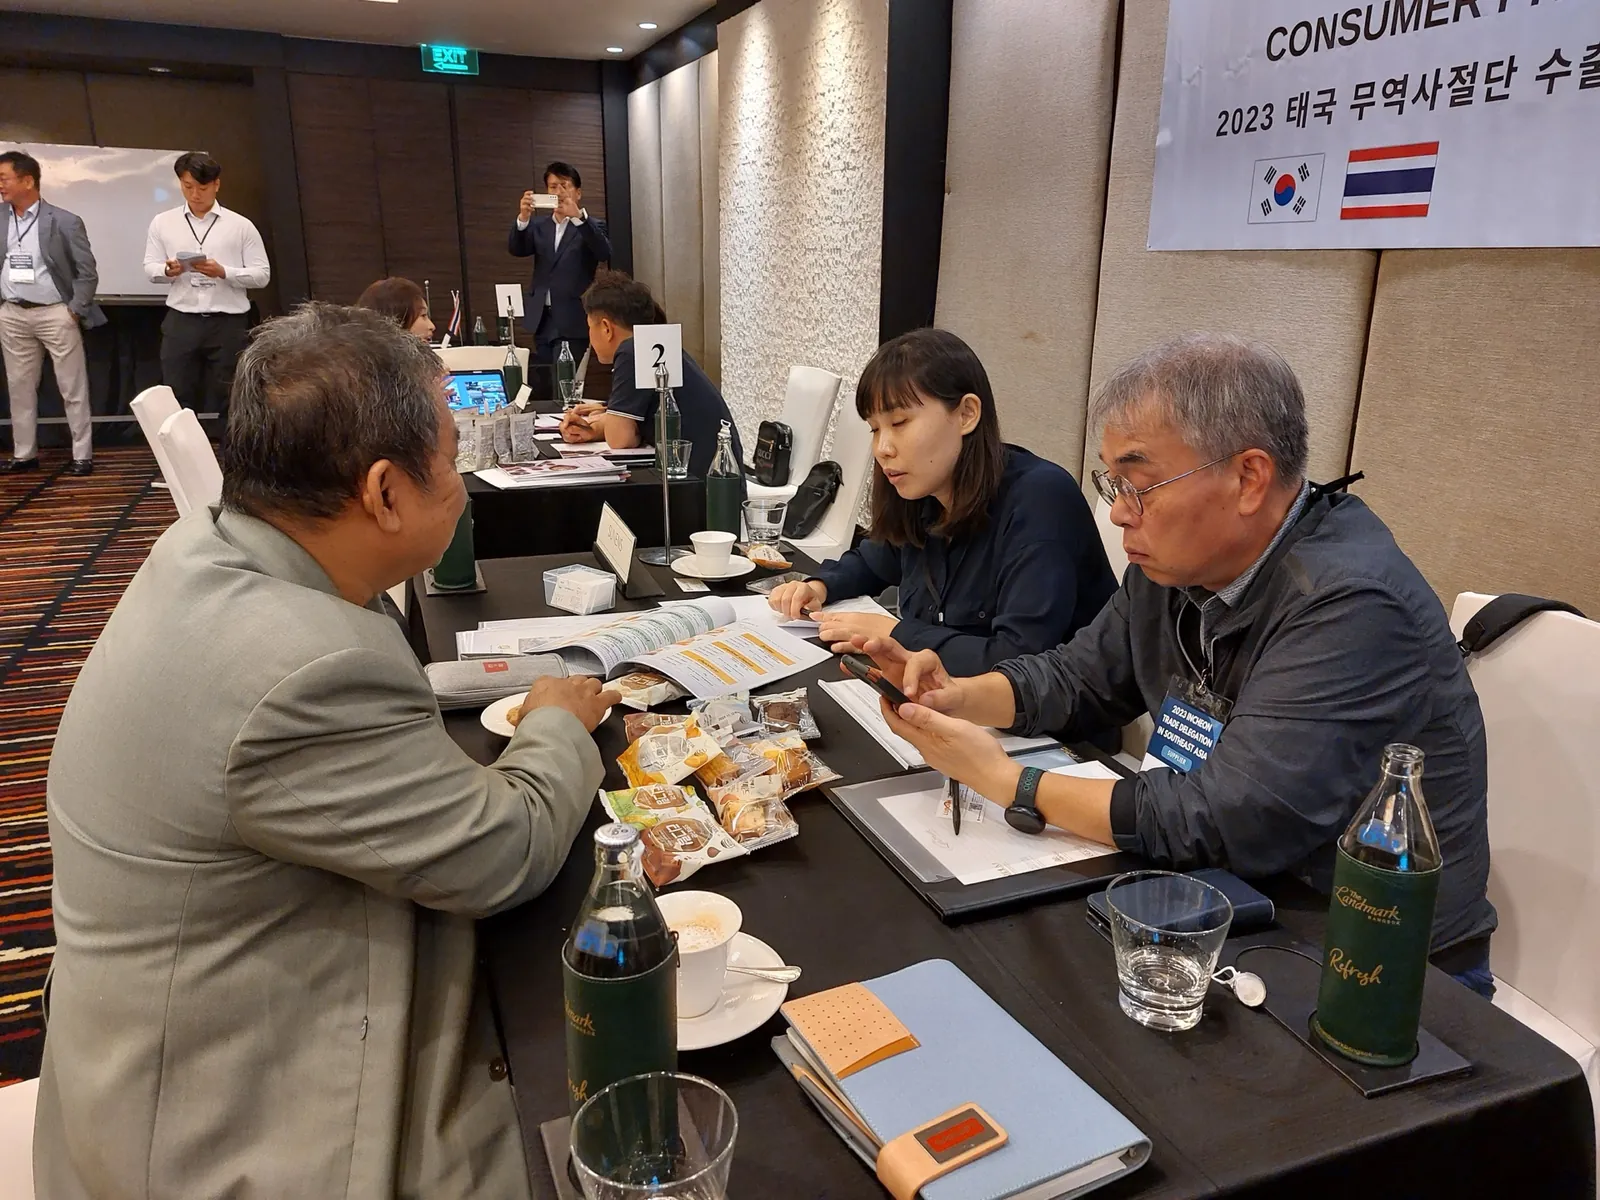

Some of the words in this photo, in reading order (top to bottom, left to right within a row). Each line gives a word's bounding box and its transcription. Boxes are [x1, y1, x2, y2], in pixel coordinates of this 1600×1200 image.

[1266, 0, 1481, 62] CONSUMER
[432, 48, 467, 63] EXIT
[1216, 103, 1274, 137] 2023
[1285, 87, 1338, 129] 태국
[1349, 55, 1518, 120] 무역사절단
[650, 343, 667, 368] 2
[1162, 714, 1181, 730] TRADE
[1179, 724, 1213, 748] DELEGATION
[1171, 705, 1187, 719] 2023
[1187, 712, 1212, 732] INCHEON
[1157, 726, 1165, 736] IN
[1164, 730, 1195, 752] SOUTHEAST
[1193, 747, 1207, 760] ASIA
[1167, 750, 1186, 764] SUPPLIER
[1335, 885, 1401, 921] Landmark
[1350, 889, 1363, 901] The
[1329, 947, 1384, 986] Refresh
